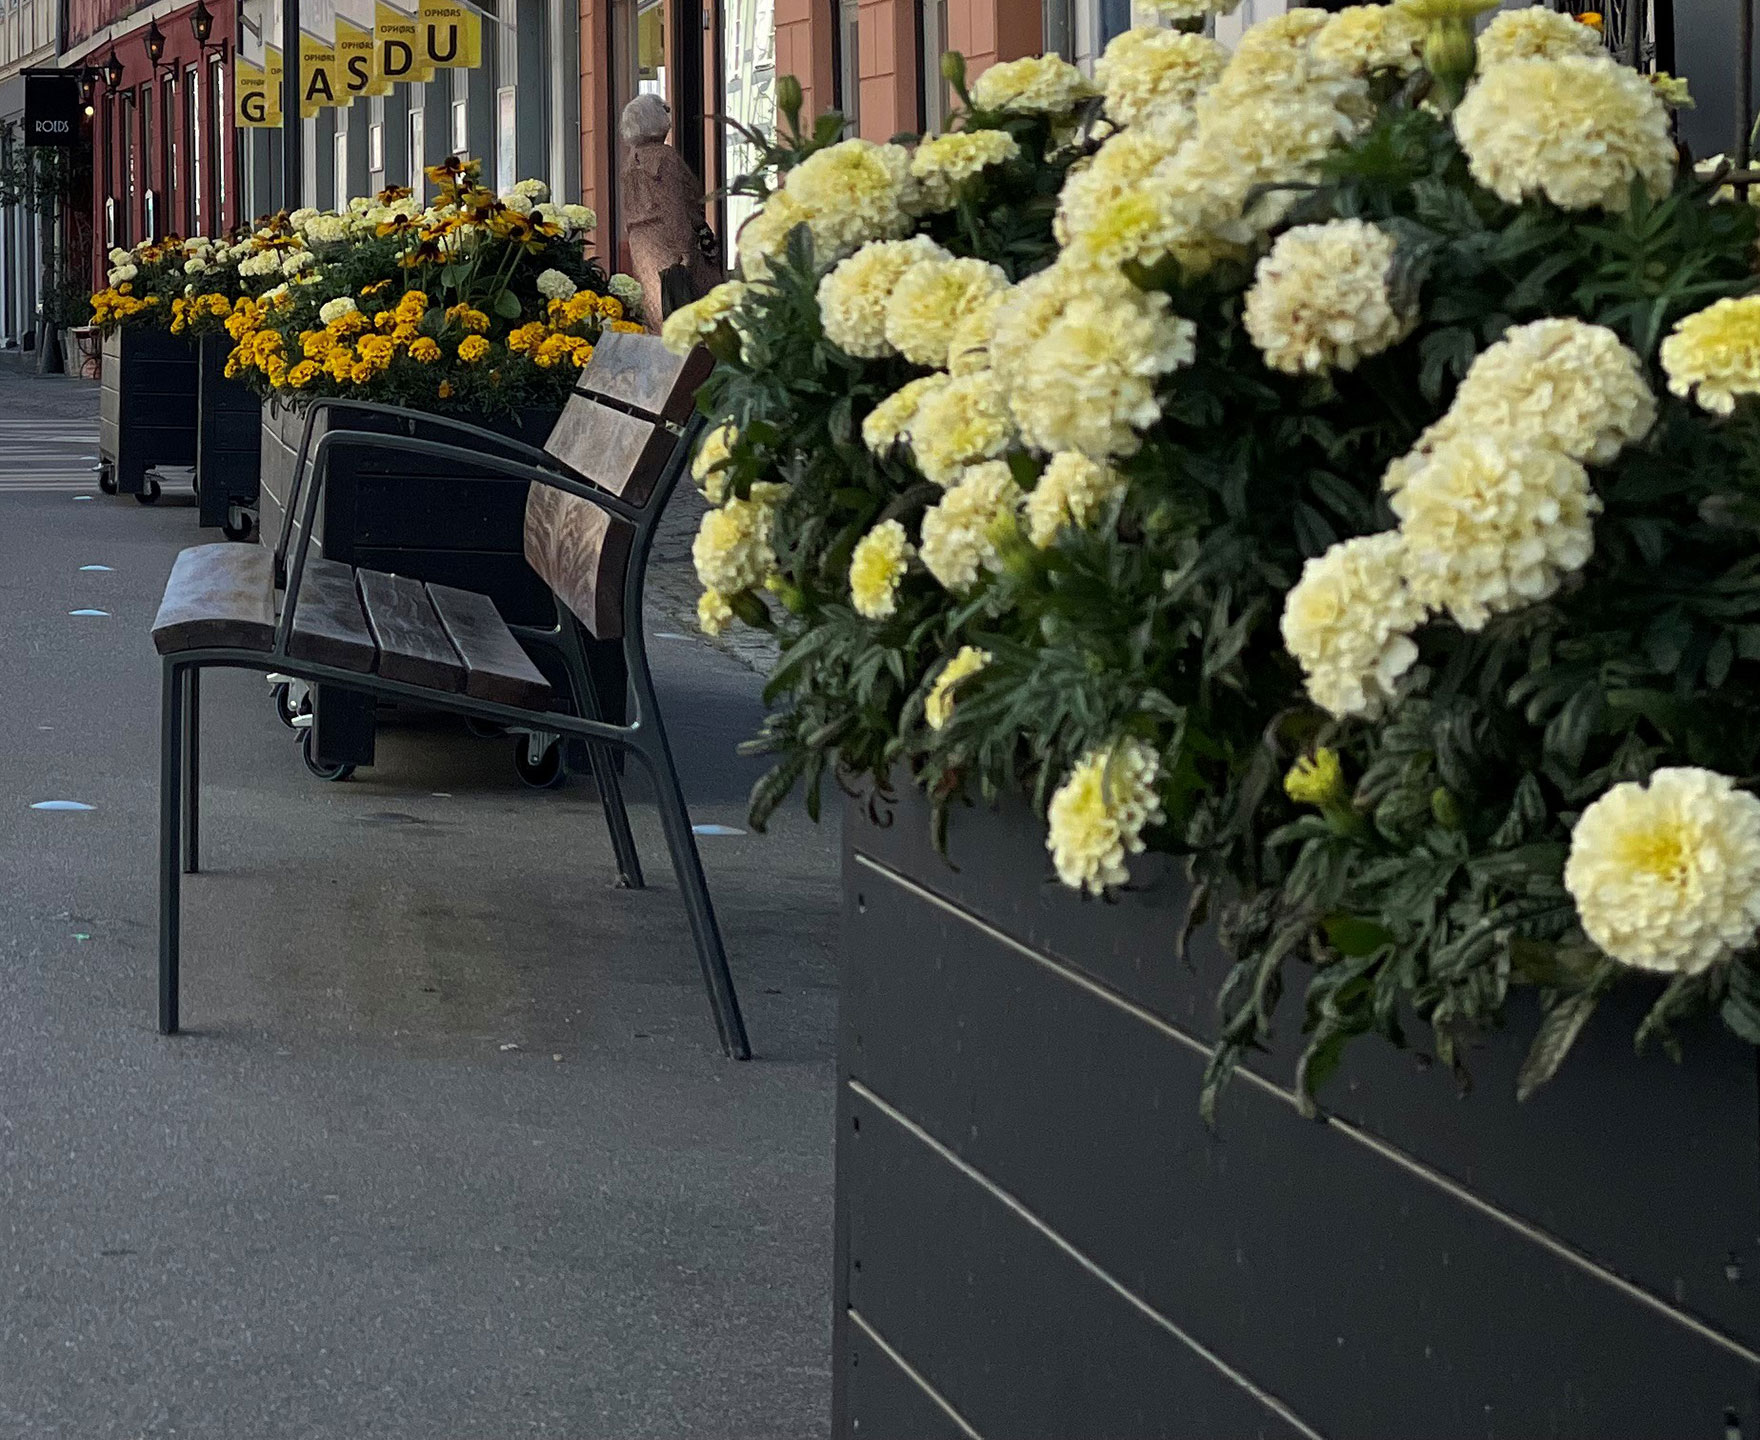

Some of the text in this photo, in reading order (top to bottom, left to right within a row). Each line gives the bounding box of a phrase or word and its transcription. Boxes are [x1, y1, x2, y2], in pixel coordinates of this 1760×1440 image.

[380, 25, 416, 34] OPHØRS
[424, 8, 461, 18] OPHØRS
[384, 40, 413, 75] D
[427, 24, 457, 62] U
[305, 67, 334, 101] A
[347, 55, 369, 91] S
[241, 91, 266, 122] G
